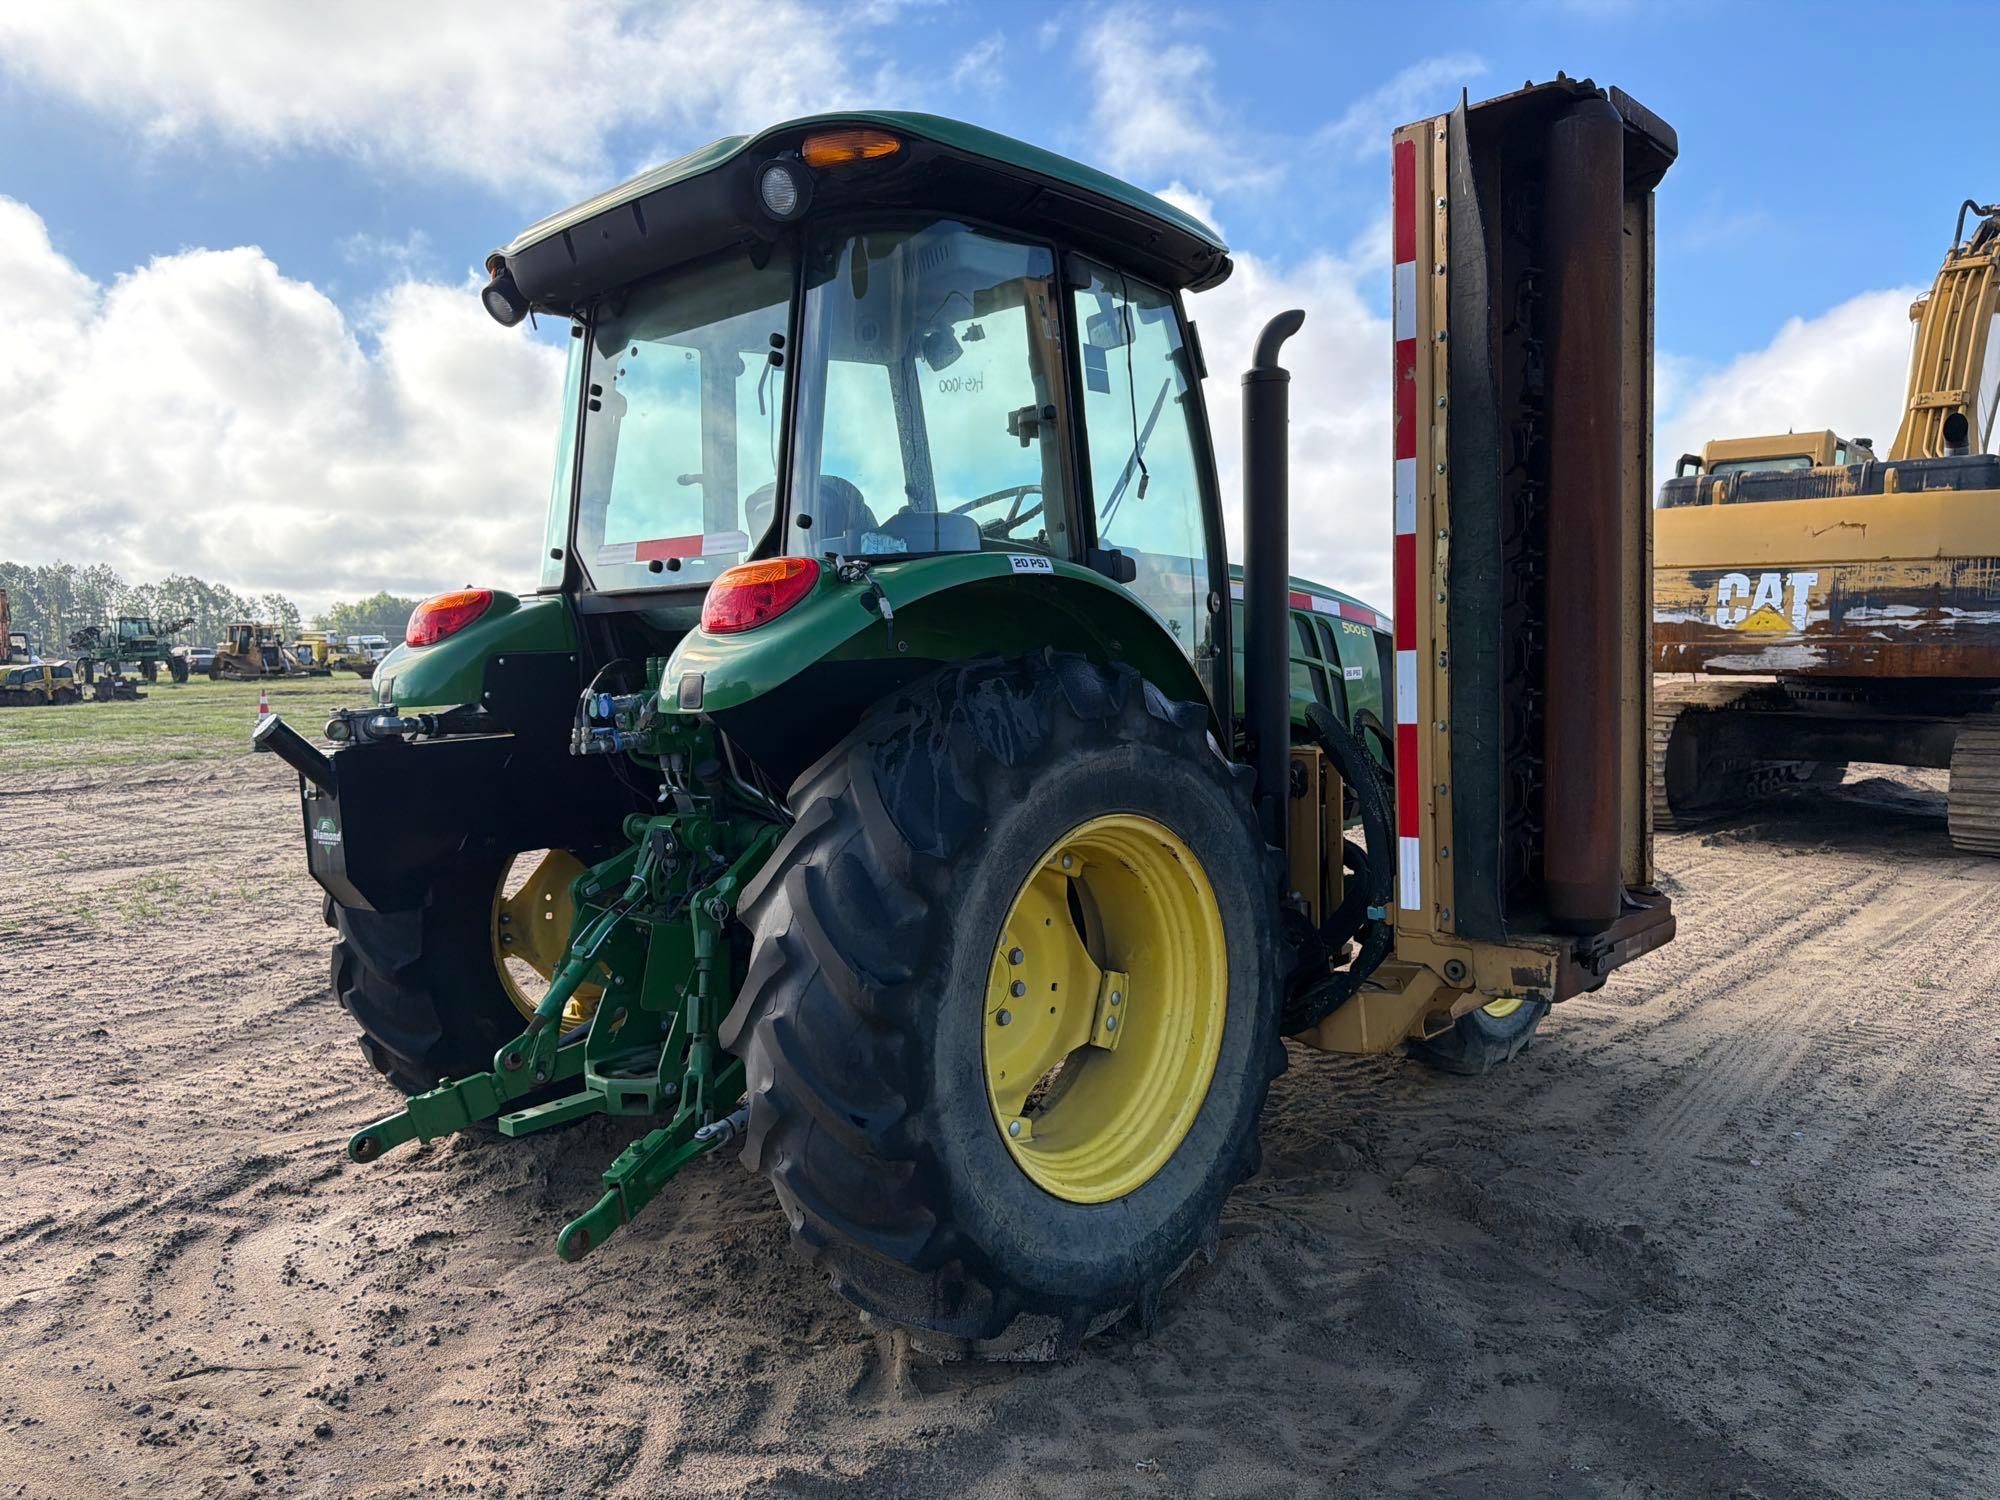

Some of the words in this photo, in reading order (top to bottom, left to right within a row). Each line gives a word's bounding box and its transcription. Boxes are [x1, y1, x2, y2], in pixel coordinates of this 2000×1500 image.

[1013, 558, 1029, 568] 20
[1029, 558, 1050, 569] PSI
[1717, 573, 1818, 631] CAT
[313, 829, 341, 842] Diamond
